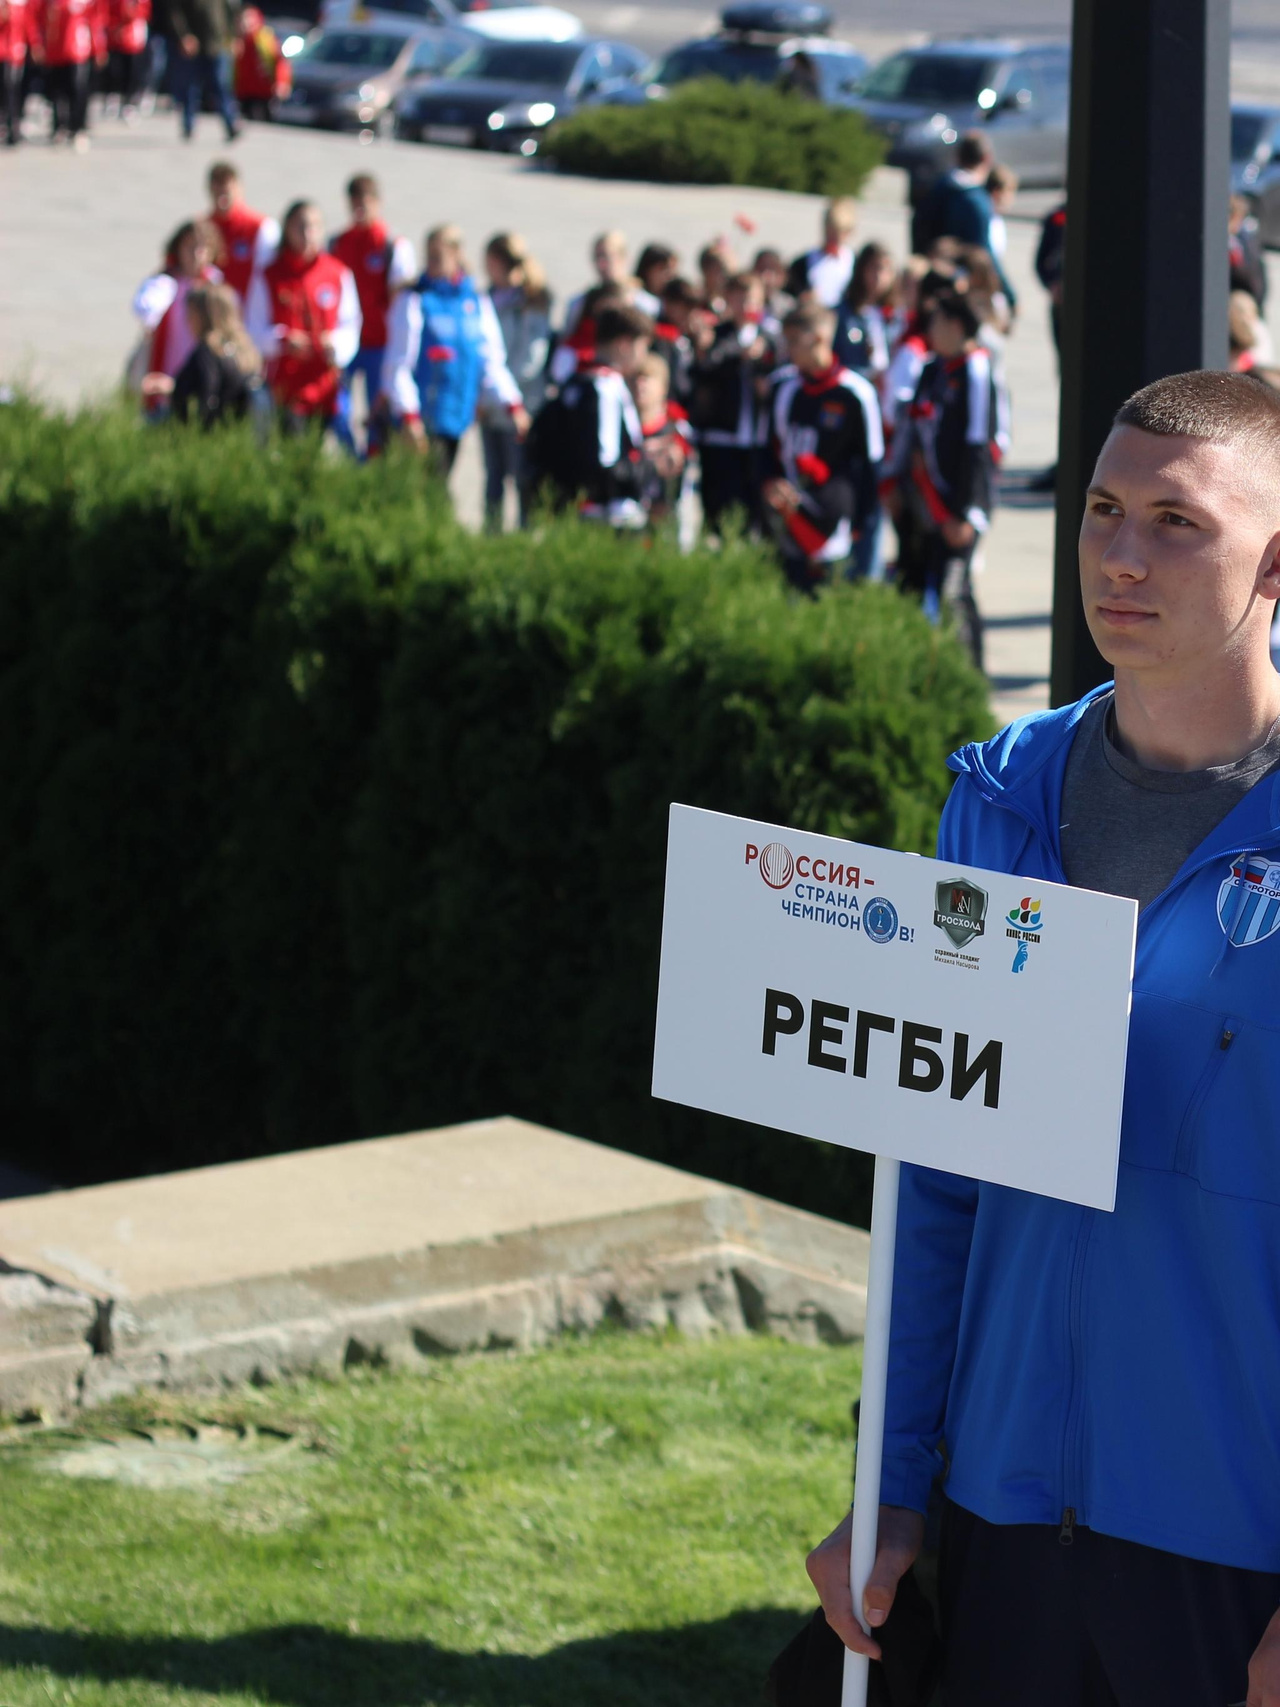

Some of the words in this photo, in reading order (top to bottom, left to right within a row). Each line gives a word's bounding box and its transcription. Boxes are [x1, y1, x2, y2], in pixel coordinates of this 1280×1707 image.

[795, 884, 859, 911] СТРАНА
[936, 914, 982, 932] ГРОСХОЛД
[761, 988, 1003, 1109] РЕГБИ
